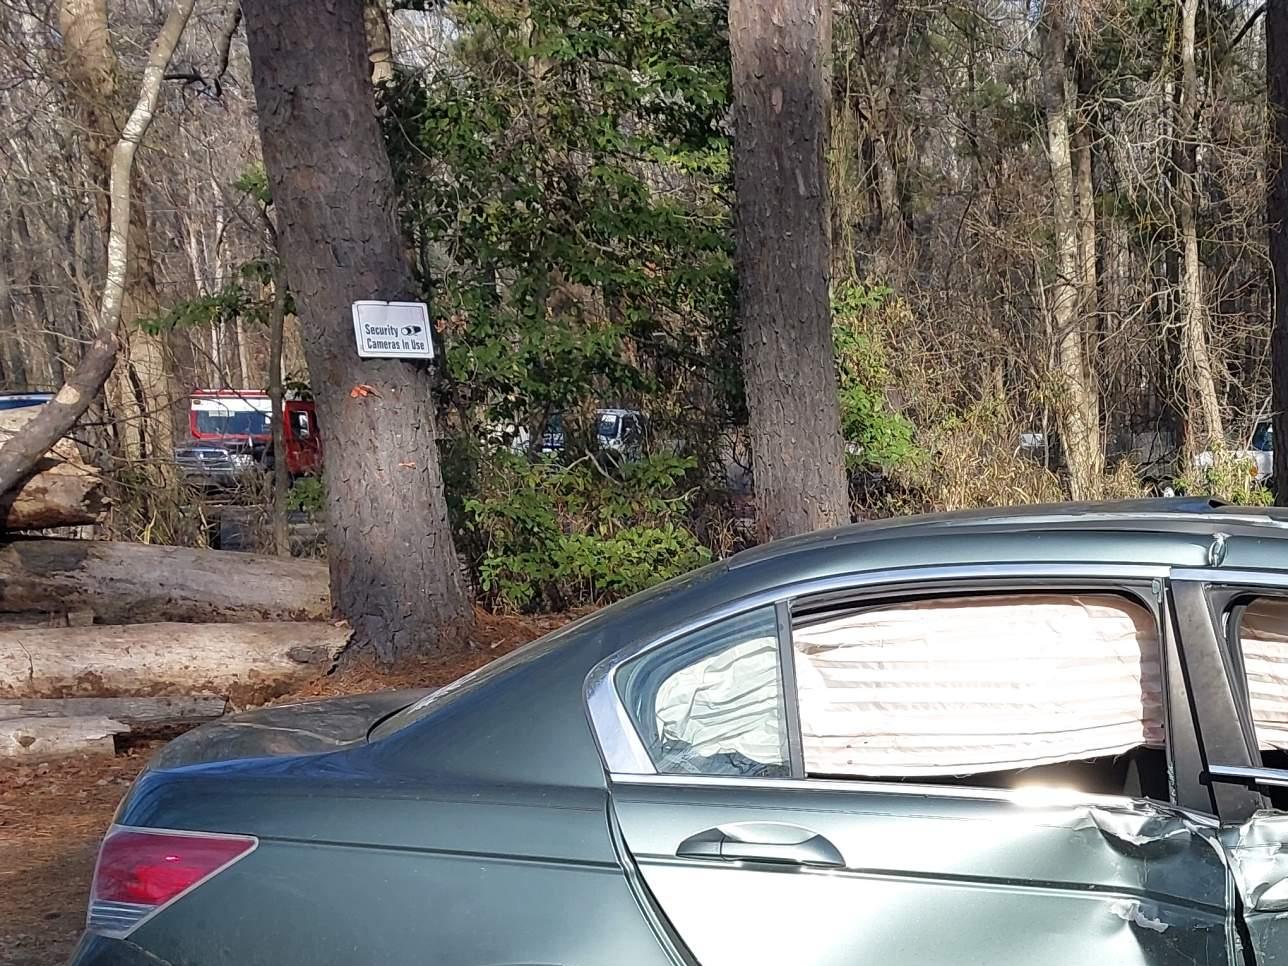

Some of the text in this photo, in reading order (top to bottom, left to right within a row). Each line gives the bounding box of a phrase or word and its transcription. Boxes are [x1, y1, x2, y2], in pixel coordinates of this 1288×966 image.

[365, 323, 399, 337] Security
[367, 338, 425, 350] Cameras In Use
